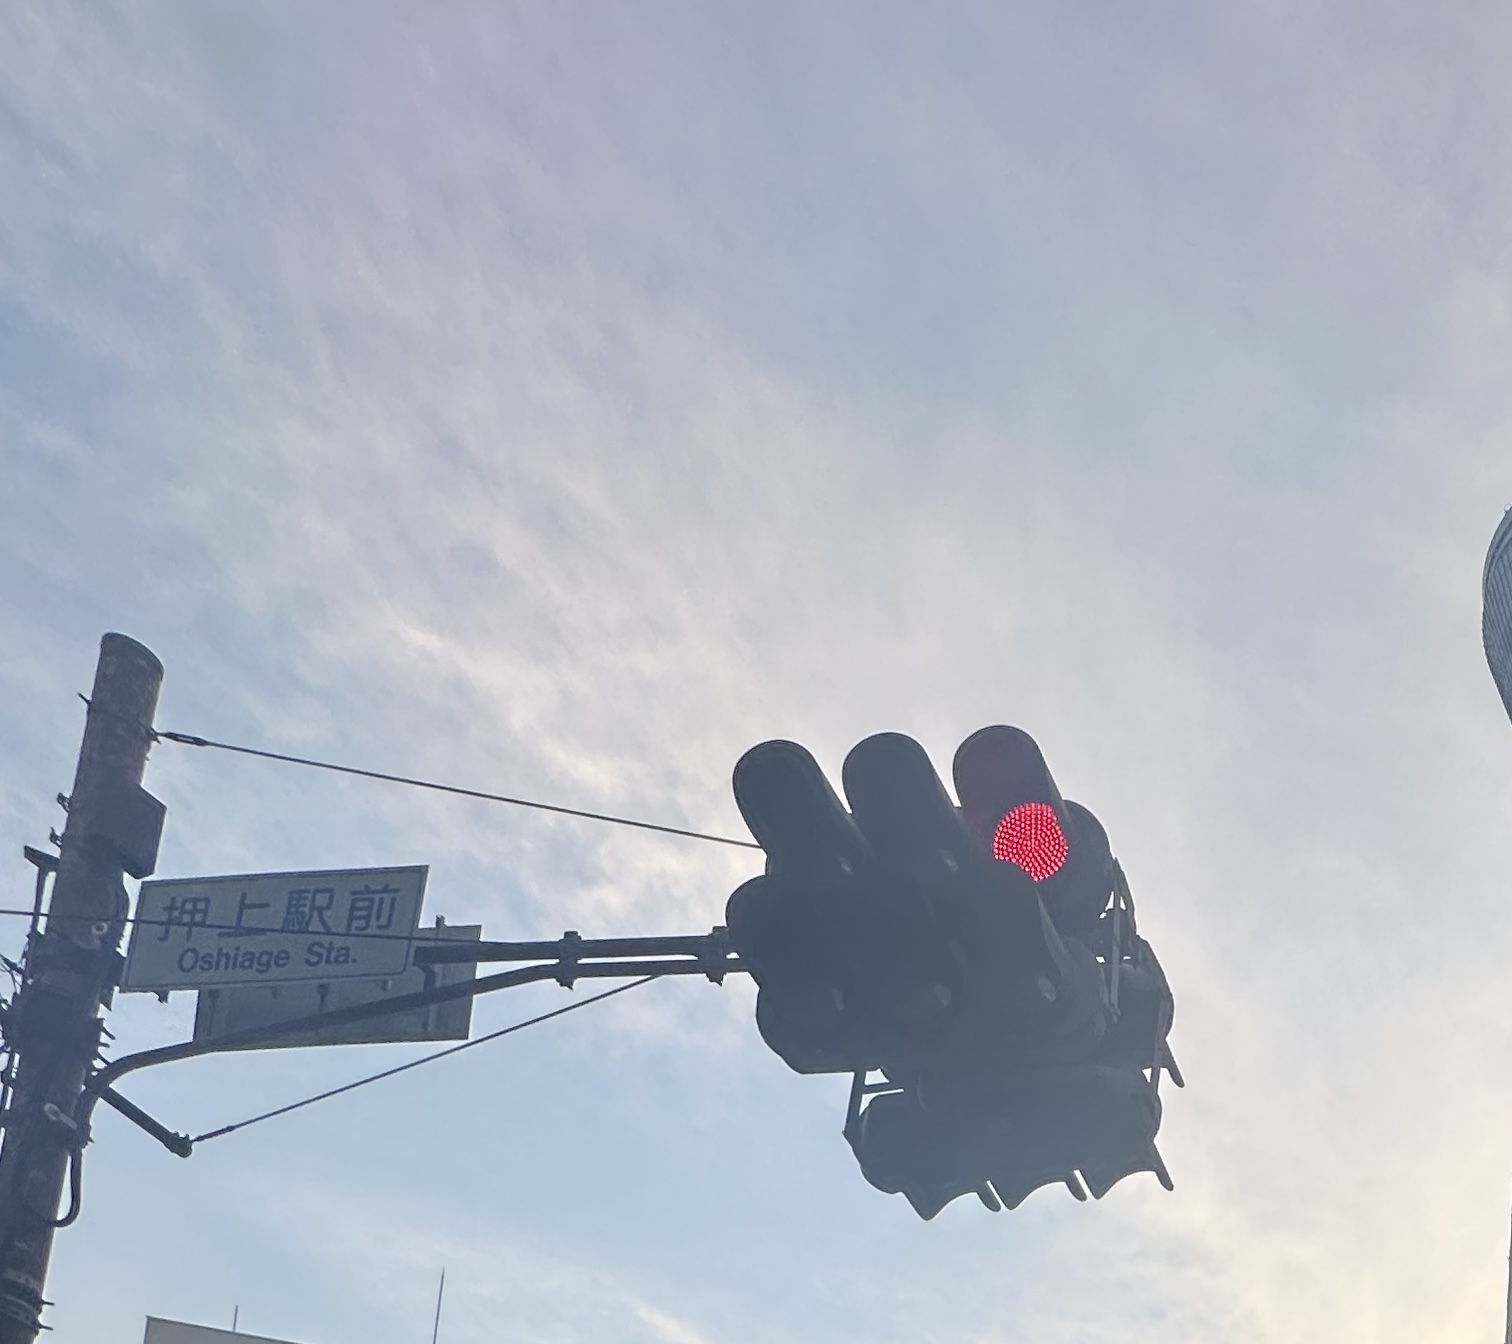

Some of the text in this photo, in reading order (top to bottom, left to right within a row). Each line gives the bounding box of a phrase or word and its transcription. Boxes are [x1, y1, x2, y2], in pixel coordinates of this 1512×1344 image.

[157, 884, 400, 942] 押上駅前
[178, 942, 358, 974] Oshiage Sta.
